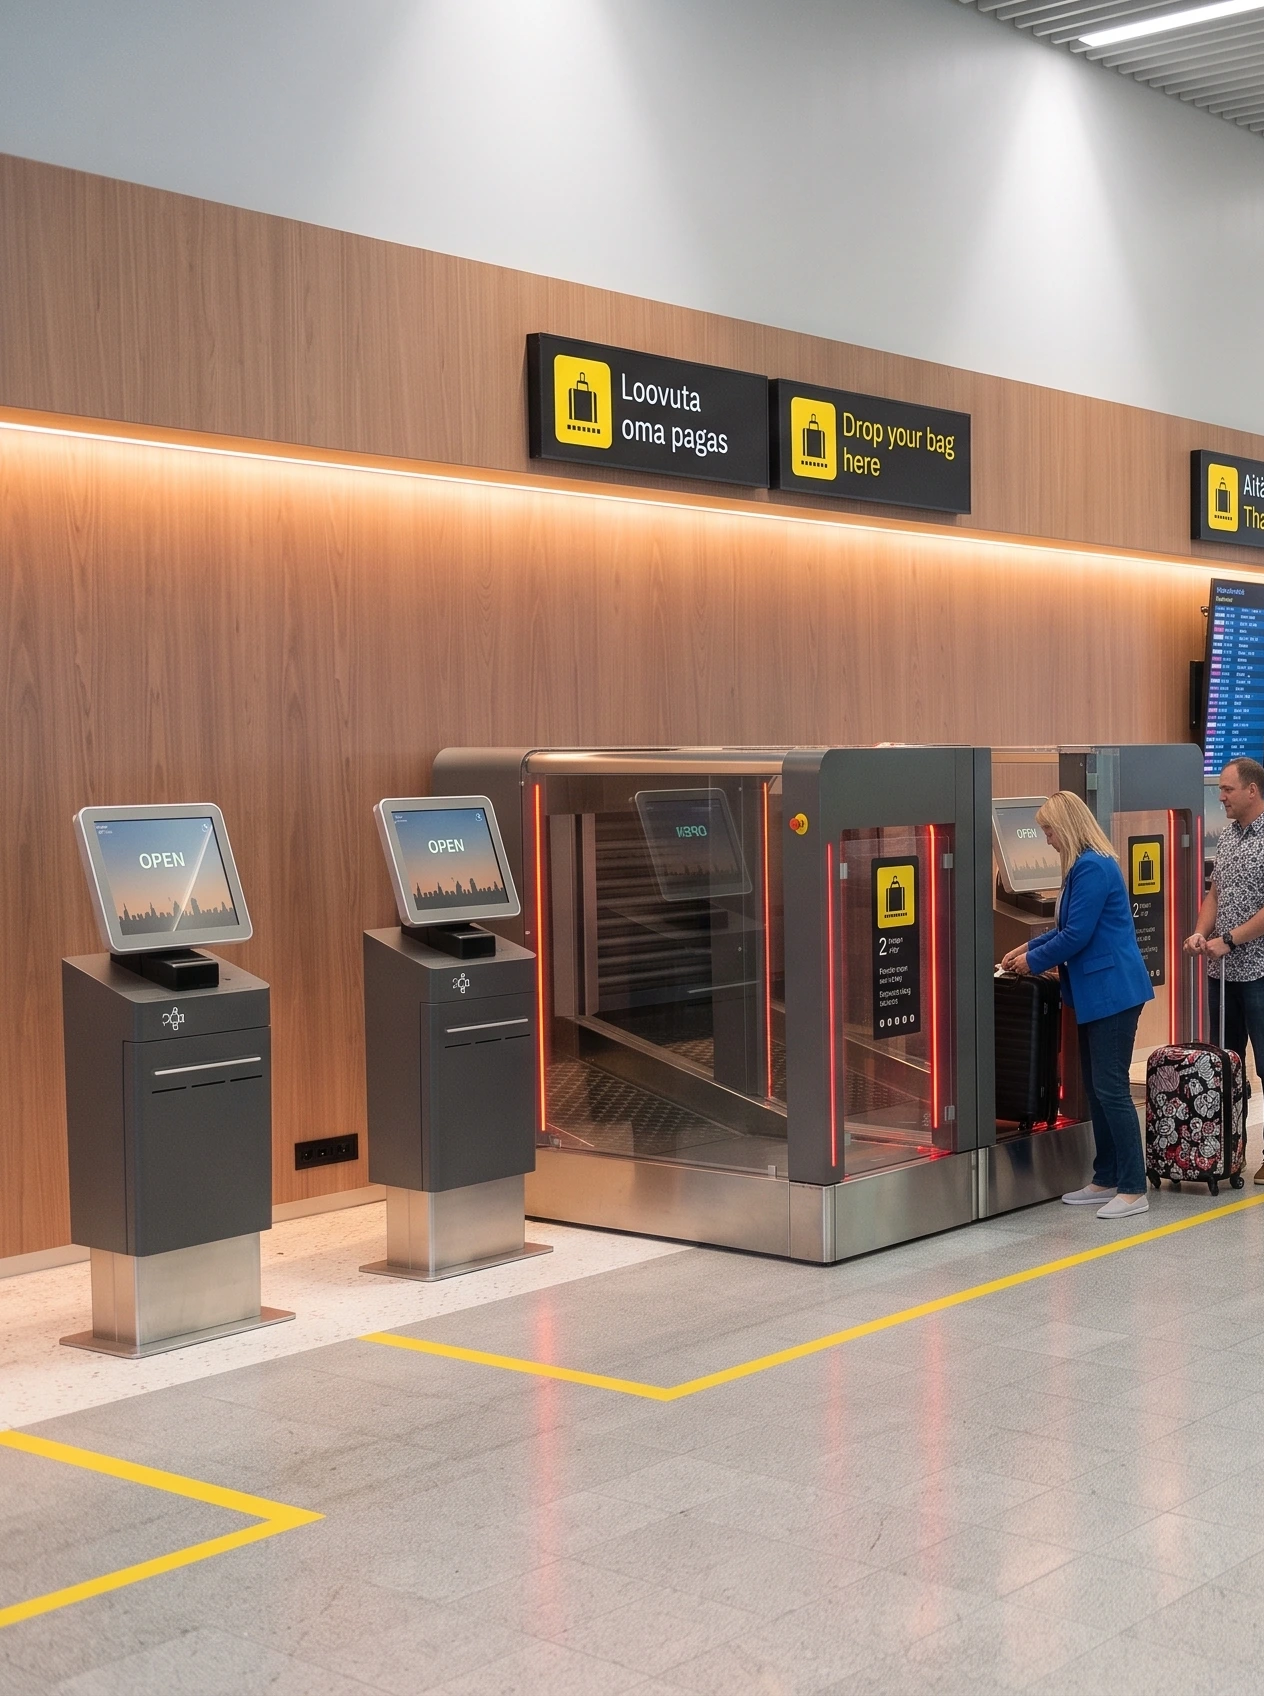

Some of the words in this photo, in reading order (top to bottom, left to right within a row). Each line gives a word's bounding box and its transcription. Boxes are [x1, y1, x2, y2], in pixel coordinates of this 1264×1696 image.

[621, 372, 702, 413] Loovuta
[621, 419, 666, 445] oma
[671, 426, 729, 457] pagas
[843, 412, 884, 447] Drop
[887, 425, 923, 450] your
[926, 427, 956, 461] bag
[843, 450, 881, 477] here
[429, 839, 465, 854] OPEN
[139, 852, 185, 869] OPEN
[879, 937, 887, 956] 2
